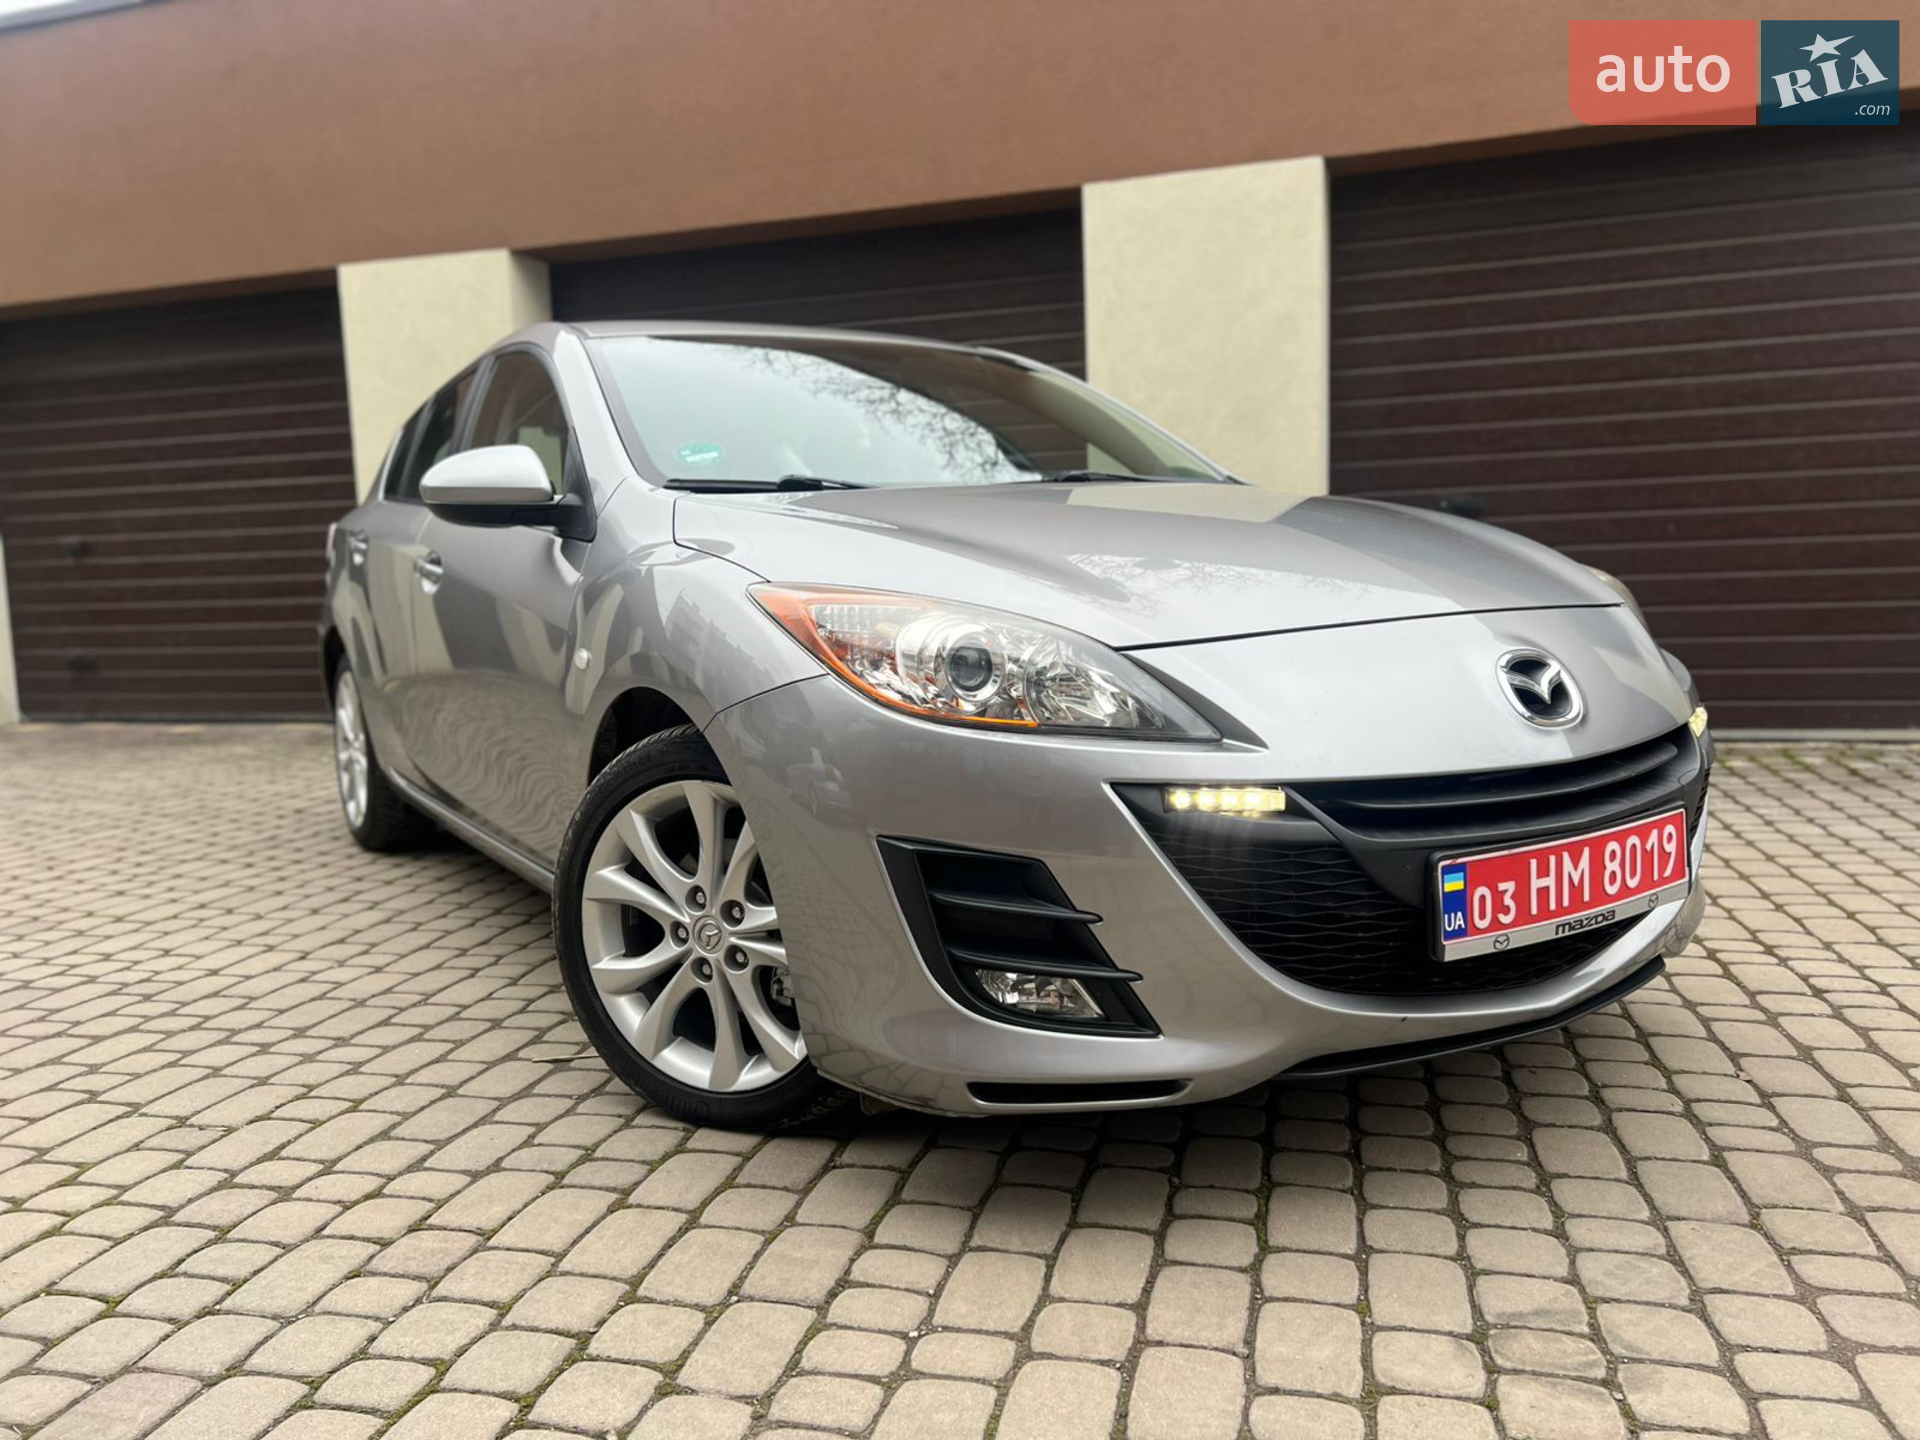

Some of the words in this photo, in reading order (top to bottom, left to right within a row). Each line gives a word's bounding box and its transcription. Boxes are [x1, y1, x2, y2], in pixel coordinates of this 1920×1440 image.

[1472, 880, 1517, 929] 03
[1529, 847, 1590, 916] HM
[1603, 824, 1678, 896] 8019
[1444, 911, 1465, 932] UA
